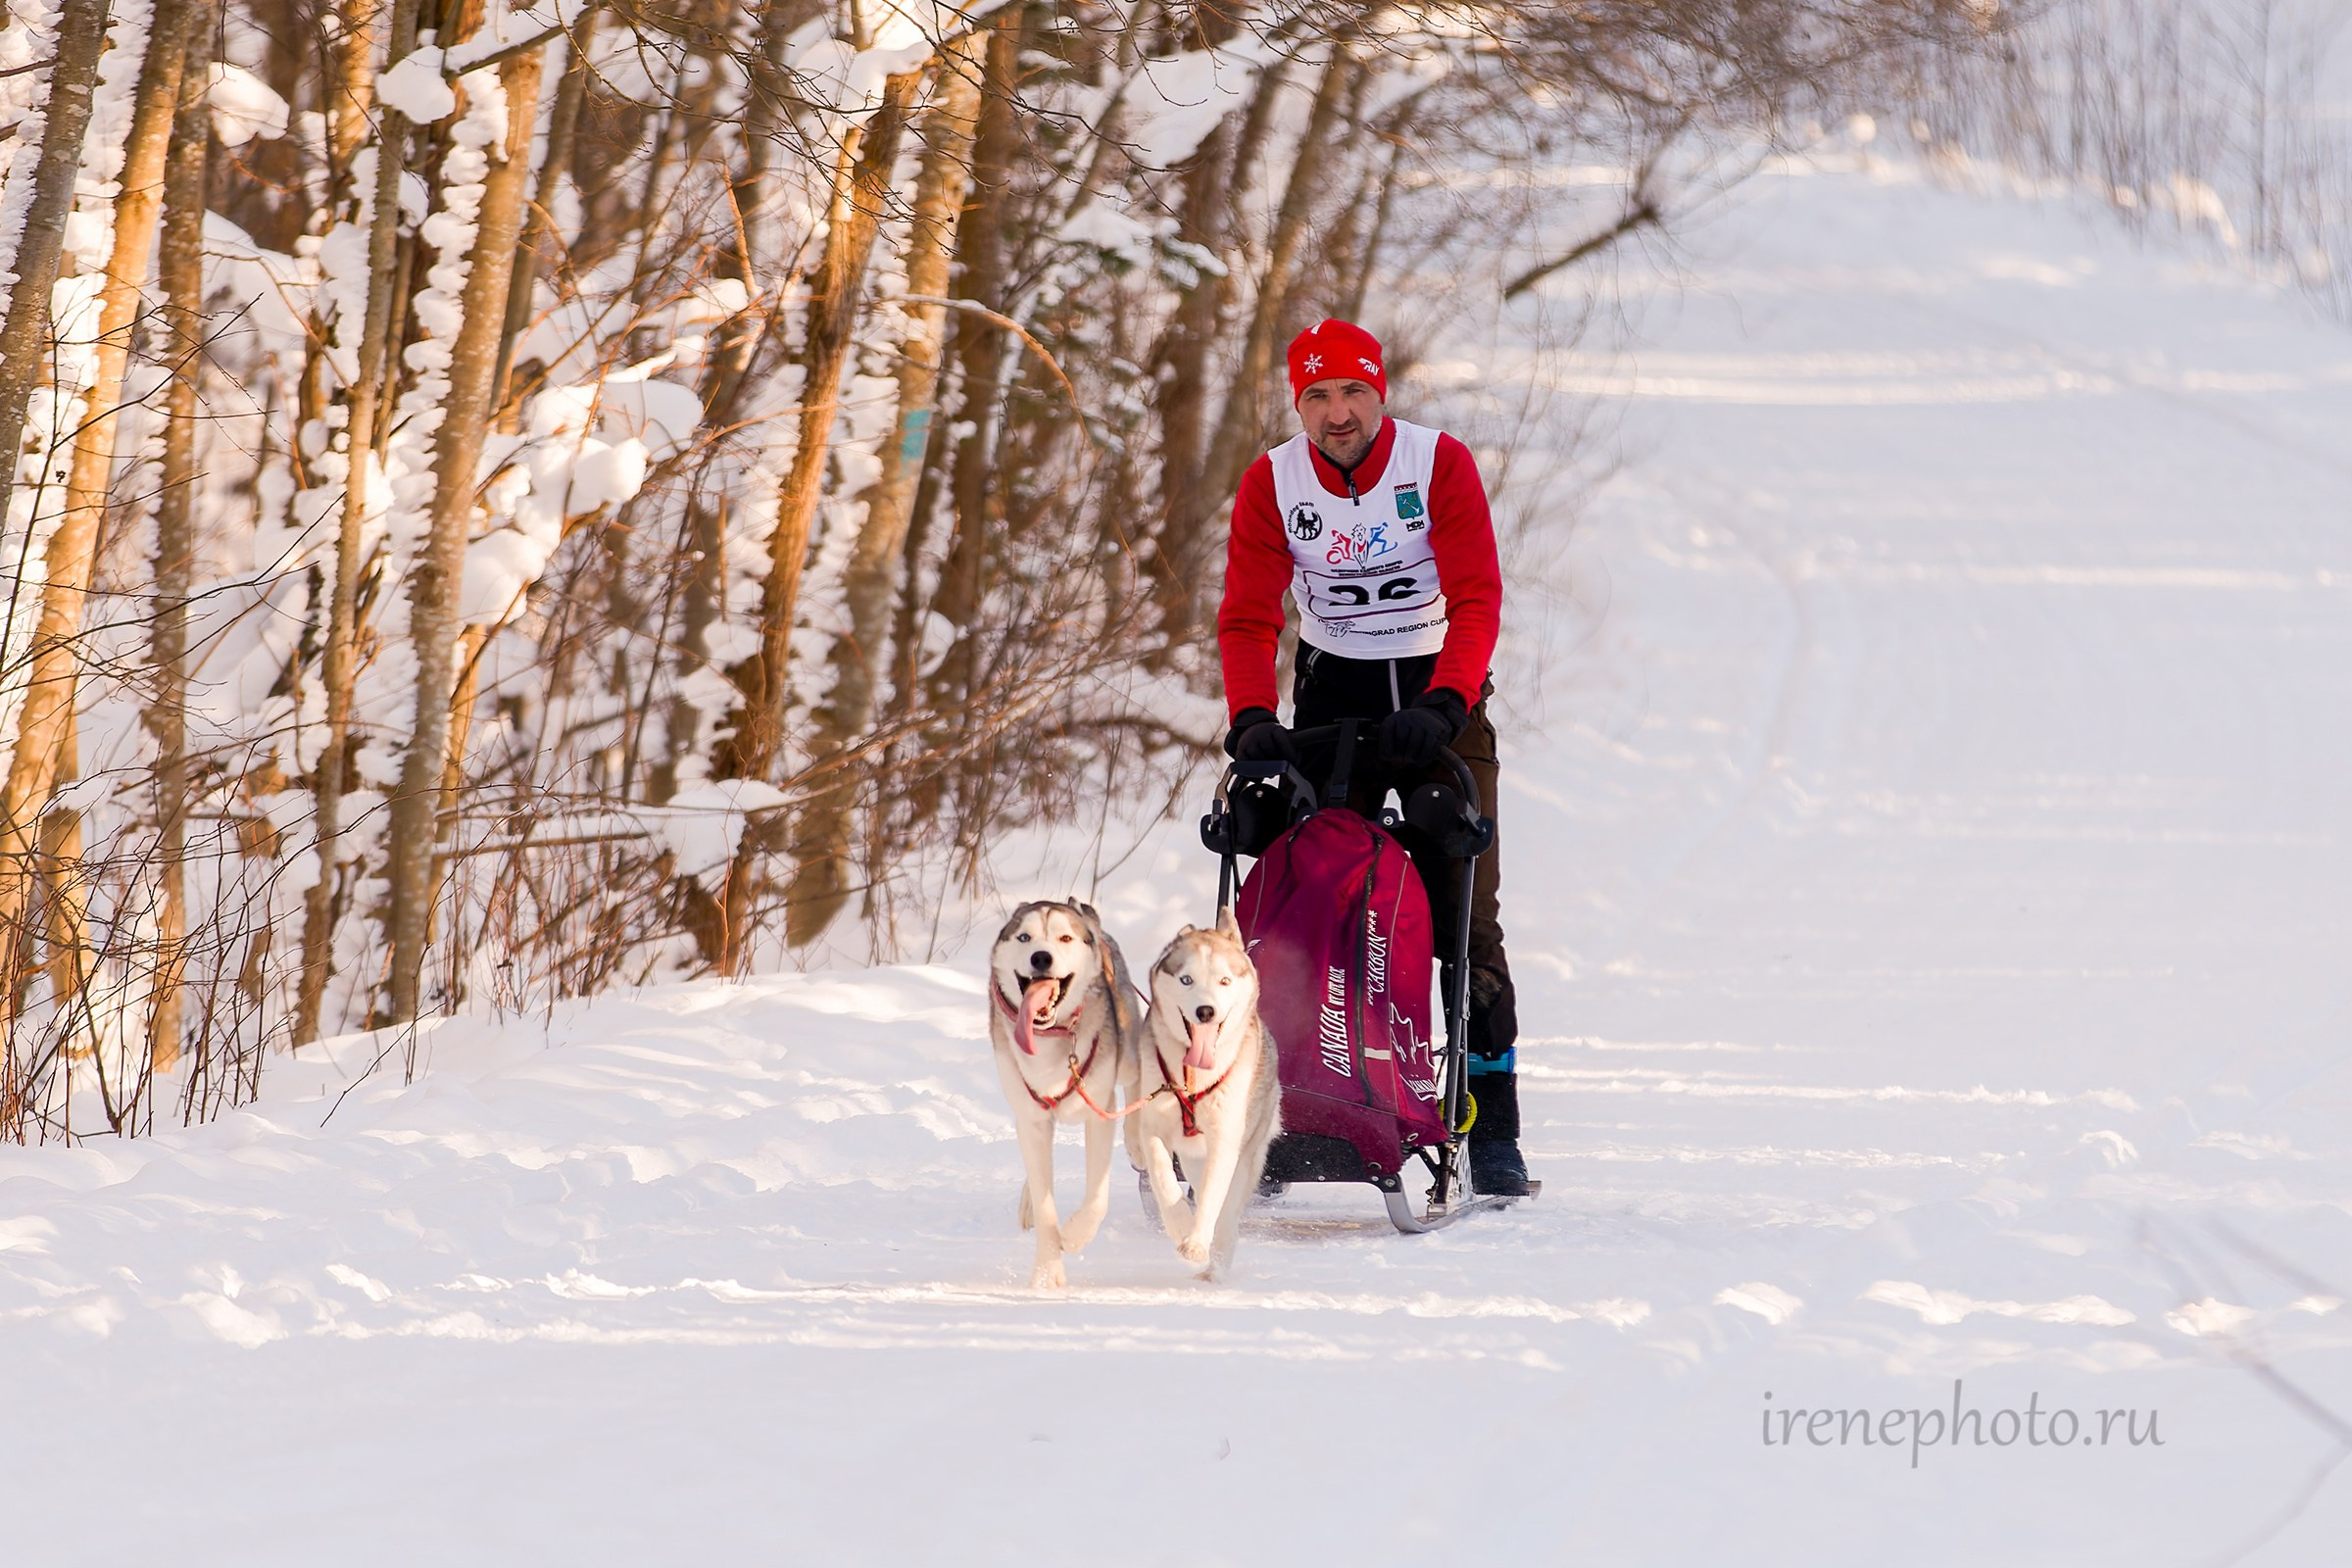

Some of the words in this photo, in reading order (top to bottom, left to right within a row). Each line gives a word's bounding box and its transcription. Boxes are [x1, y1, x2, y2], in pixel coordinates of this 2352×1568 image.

[1368, 628, 1396, 637] GRAD
[1396, 621, 1429, 634] REGION
[1430, 616, 1446, 627] CUP
[1319, 1004, 1351, 1077] CANADA
